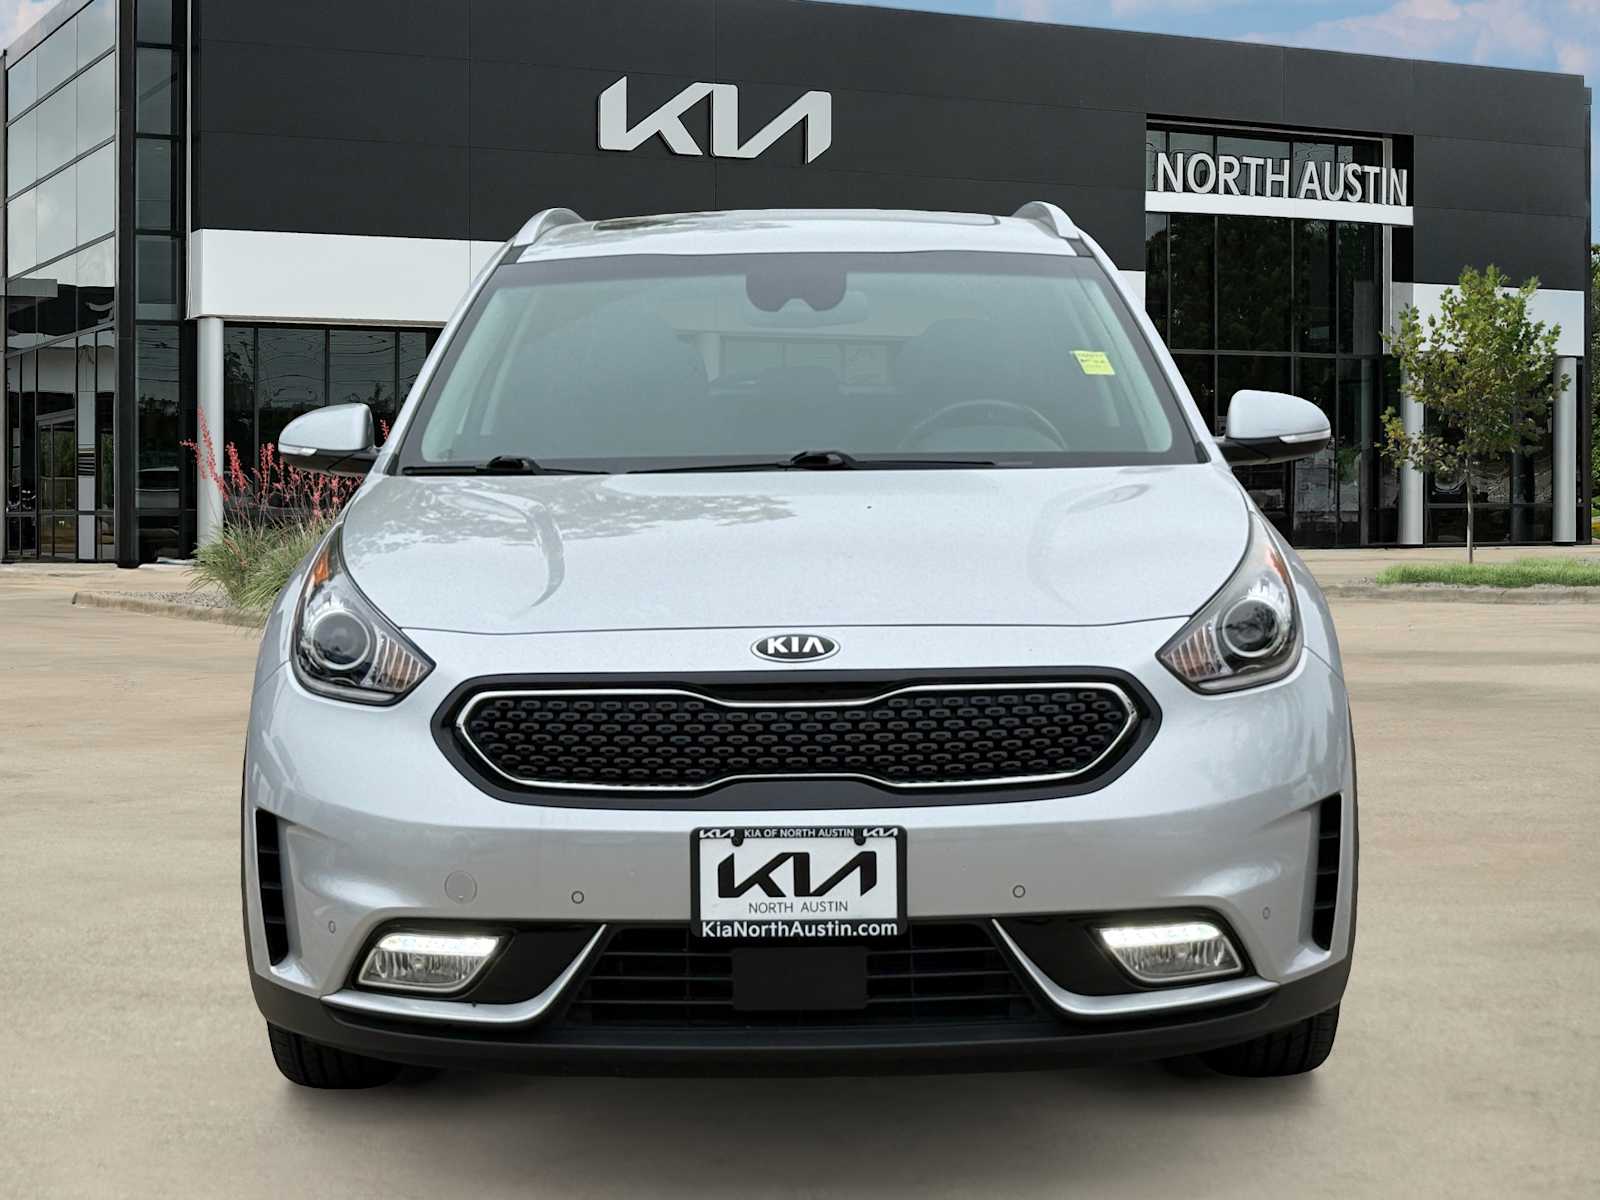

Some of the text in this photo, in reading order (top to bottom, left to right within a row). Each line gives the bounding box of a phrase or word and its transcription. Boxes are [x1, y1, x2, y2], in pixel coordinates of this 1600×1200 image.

[598, 75, 832, 164] KIA
[1157, 151, 1408, 206] NORTH AUSTIN
[767, 636, 825, 654] KIA
[744, 828, 854, 838] KIA OF NORTH AUSTIN
[717, 850, 877, 898] KIA
[748, 901, 848, 914] NORTH AUSTIN
[702, 920, 898, 937] KiaNorthAustin.com
